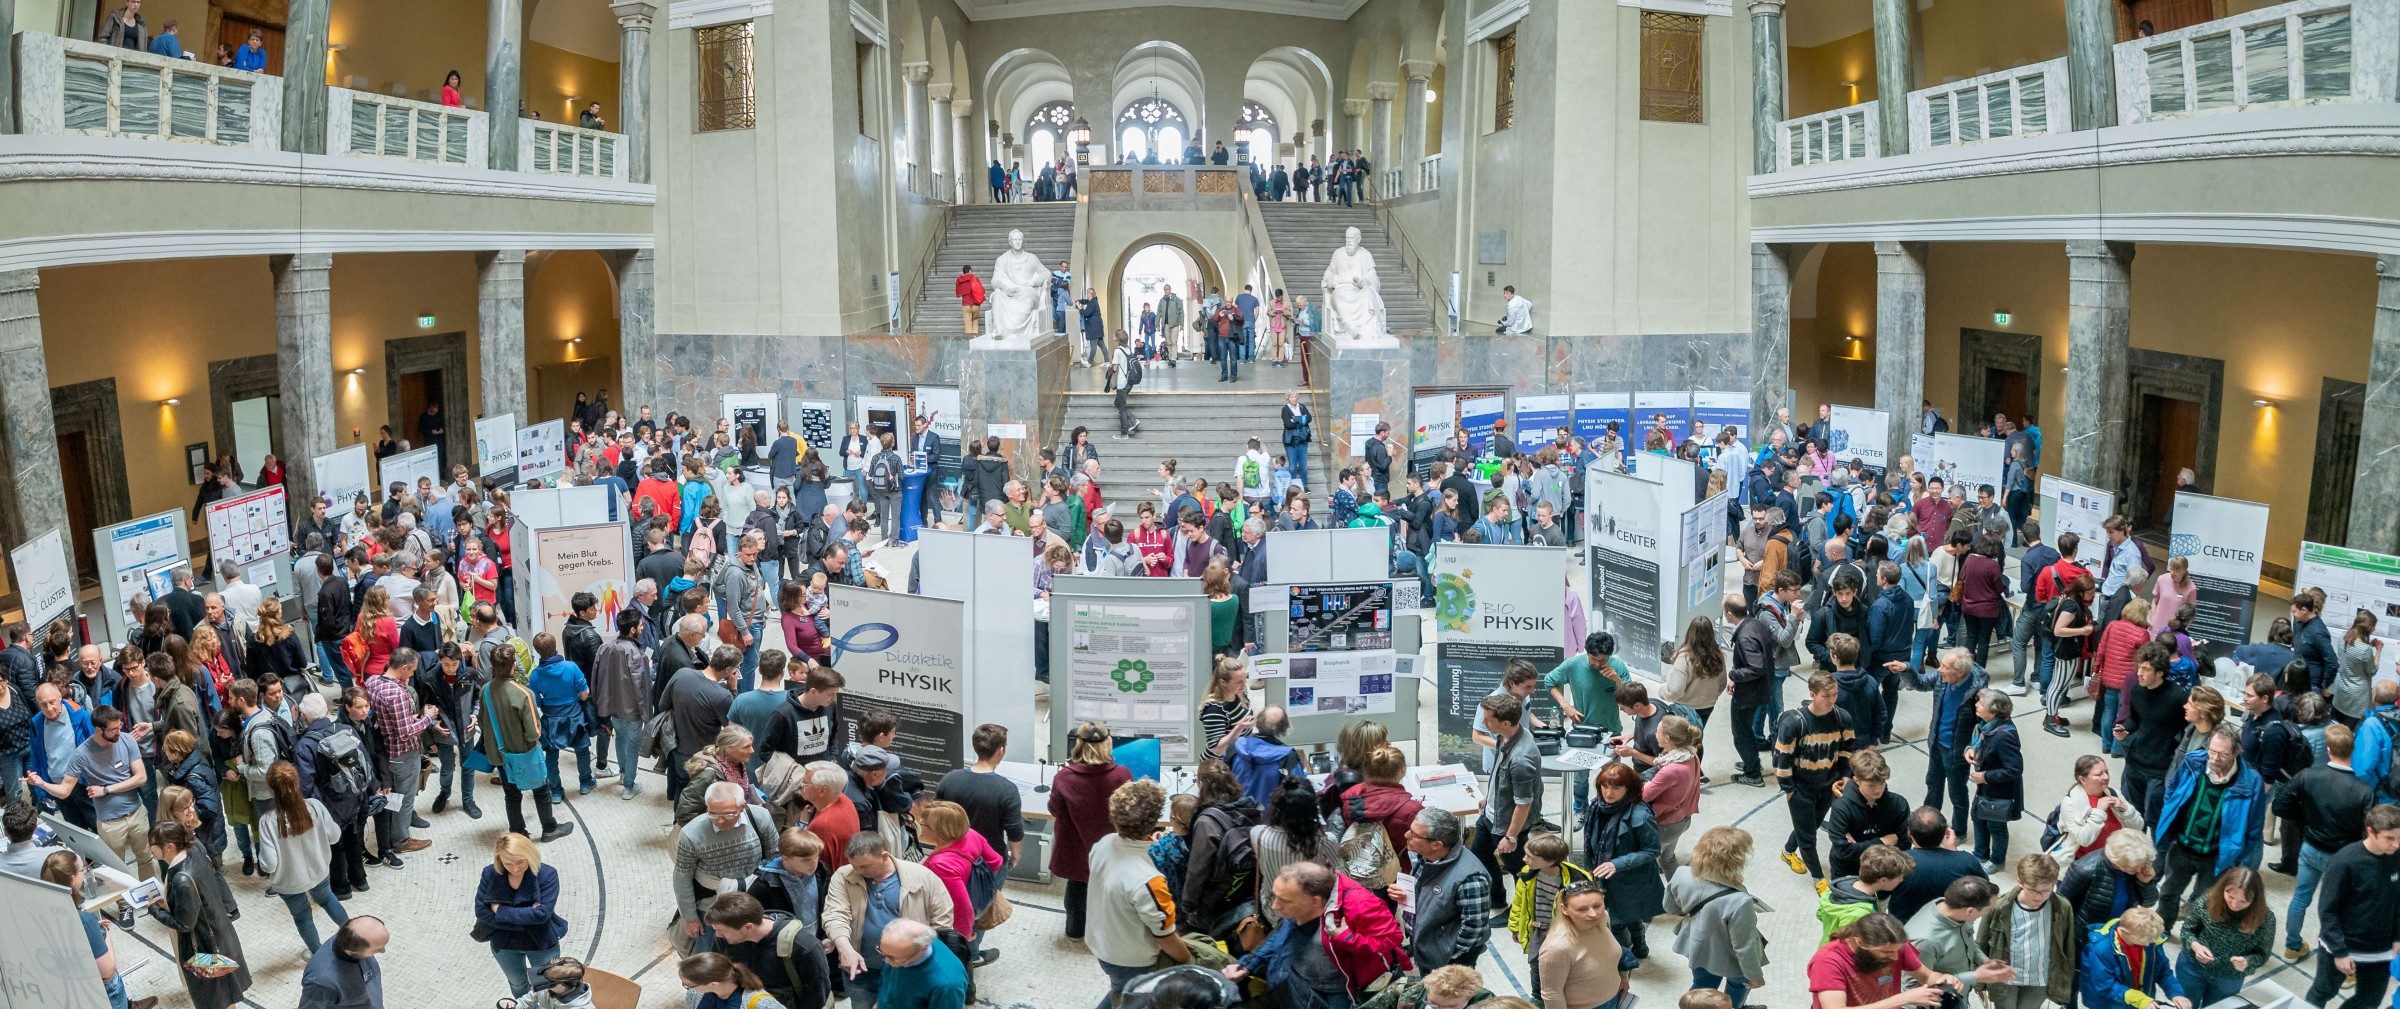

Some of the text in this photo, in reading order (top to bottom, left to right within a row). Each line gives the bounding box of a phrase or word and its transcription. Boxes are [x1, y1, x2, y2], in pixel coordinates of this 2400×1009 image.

[1428, 422, 1451, 432] PHYSIK
[492, 450, 513, 463] PHYSIK
[1850, 448, 1884, 458] CLUSTER
[1617, 530, 1656, 549] CENTER
[2203, 545, 2255, 562] CENTER
[558, 562, 585, 571] gegen
[1598, 564, 1606, 600] Angebot!
[40, 587, 66, 611] CLUSTER
[1482, 602, 1515, 614] BIO
[1484, 616, 1554, 630] PHYSIK
[885, 650, 954, 669] Didaktik
[878, 668, 953, 694] PHYSIK
[854, 690, 875, 698] machen
[903, 698, 947, 708] Physikdidaktik?
[1450, 668, 1461, 716] Forschung
[804, 741, 825, 750] adidas
